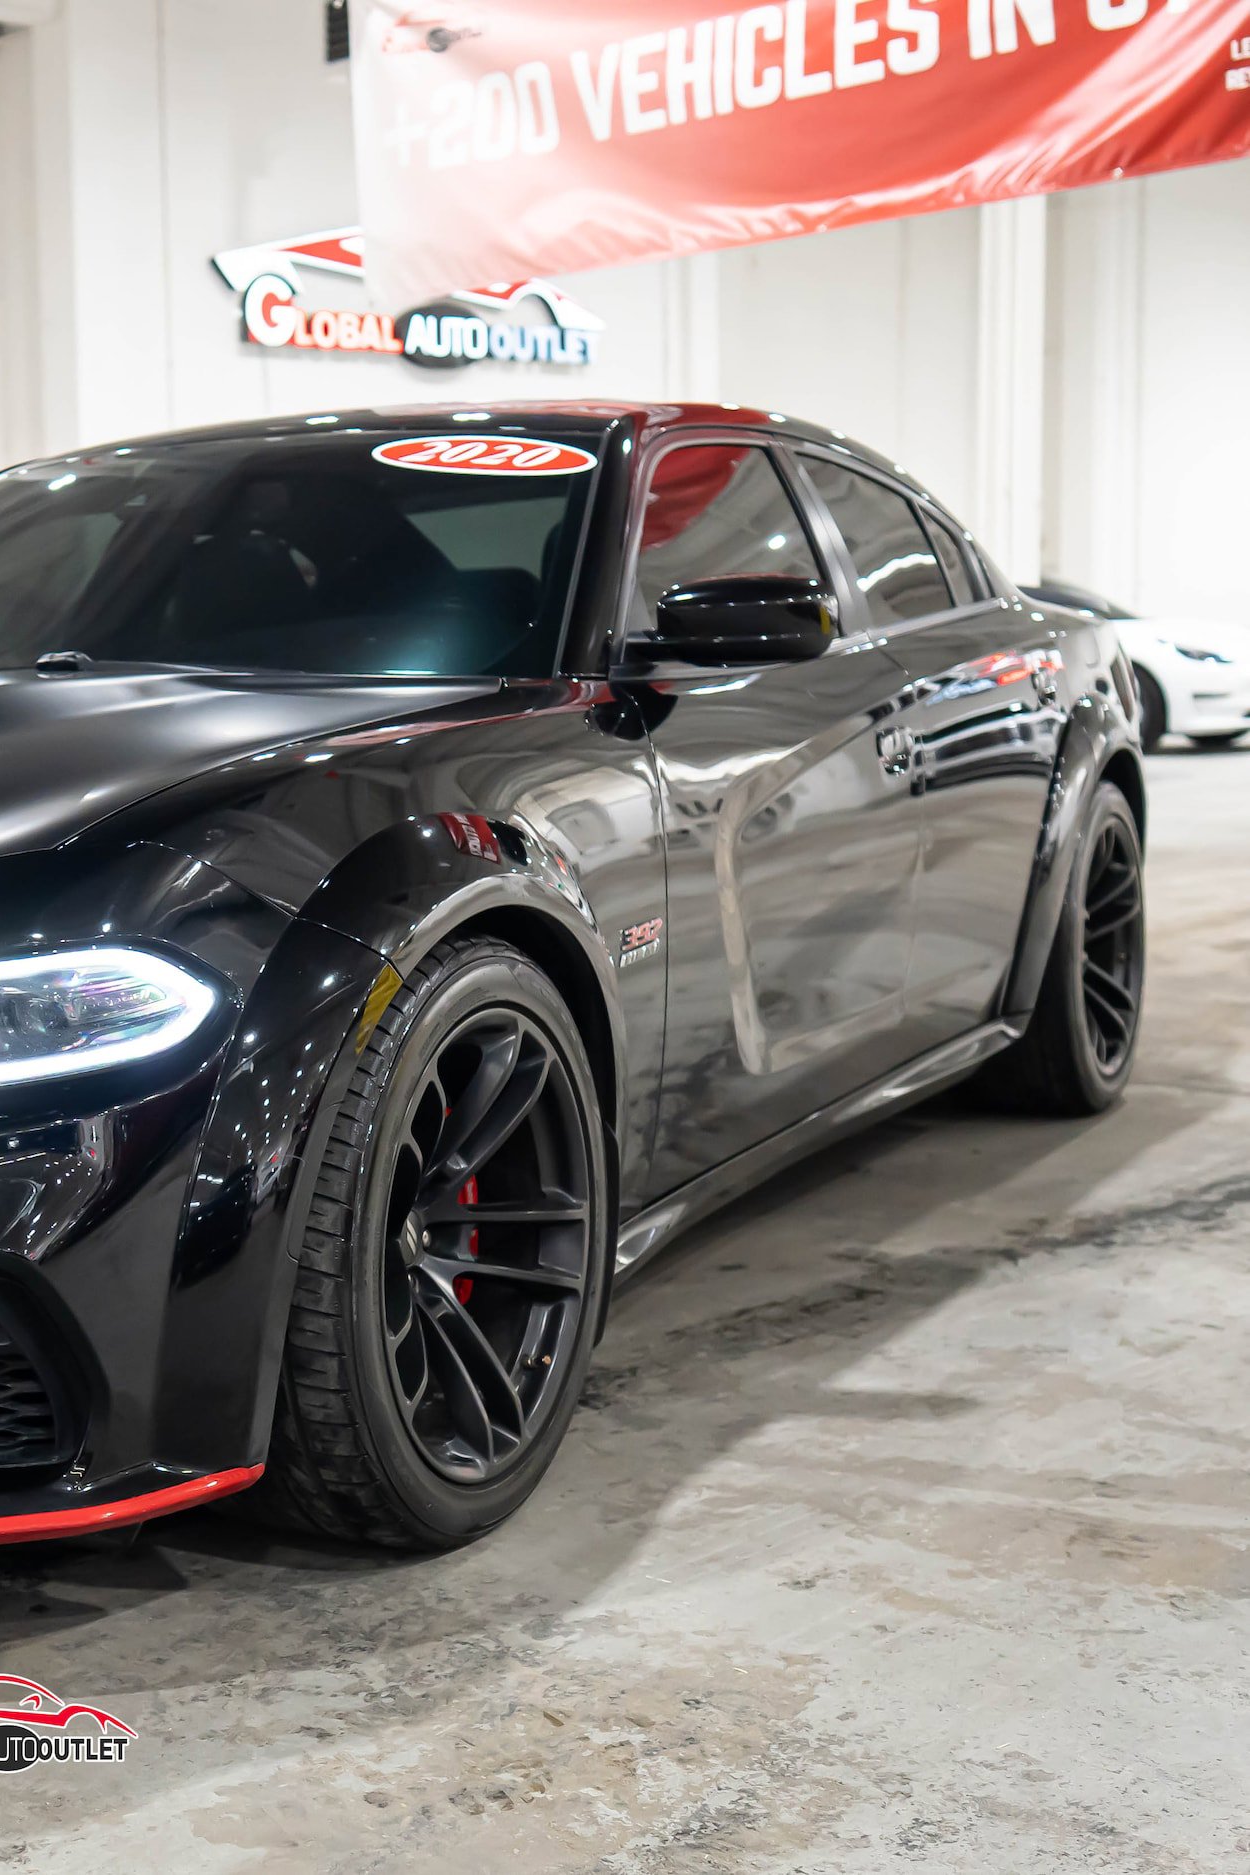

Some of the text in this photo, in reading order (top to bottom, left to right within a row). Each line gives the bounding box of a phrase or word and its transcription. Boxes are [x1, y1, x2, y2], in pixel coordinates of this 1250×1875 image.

[569, 0, 940, 142] VEHICLES
[244, 273, 601, 365] GLOBAL AUTO OUTLET
[398, 441, 561, 468] 2020
